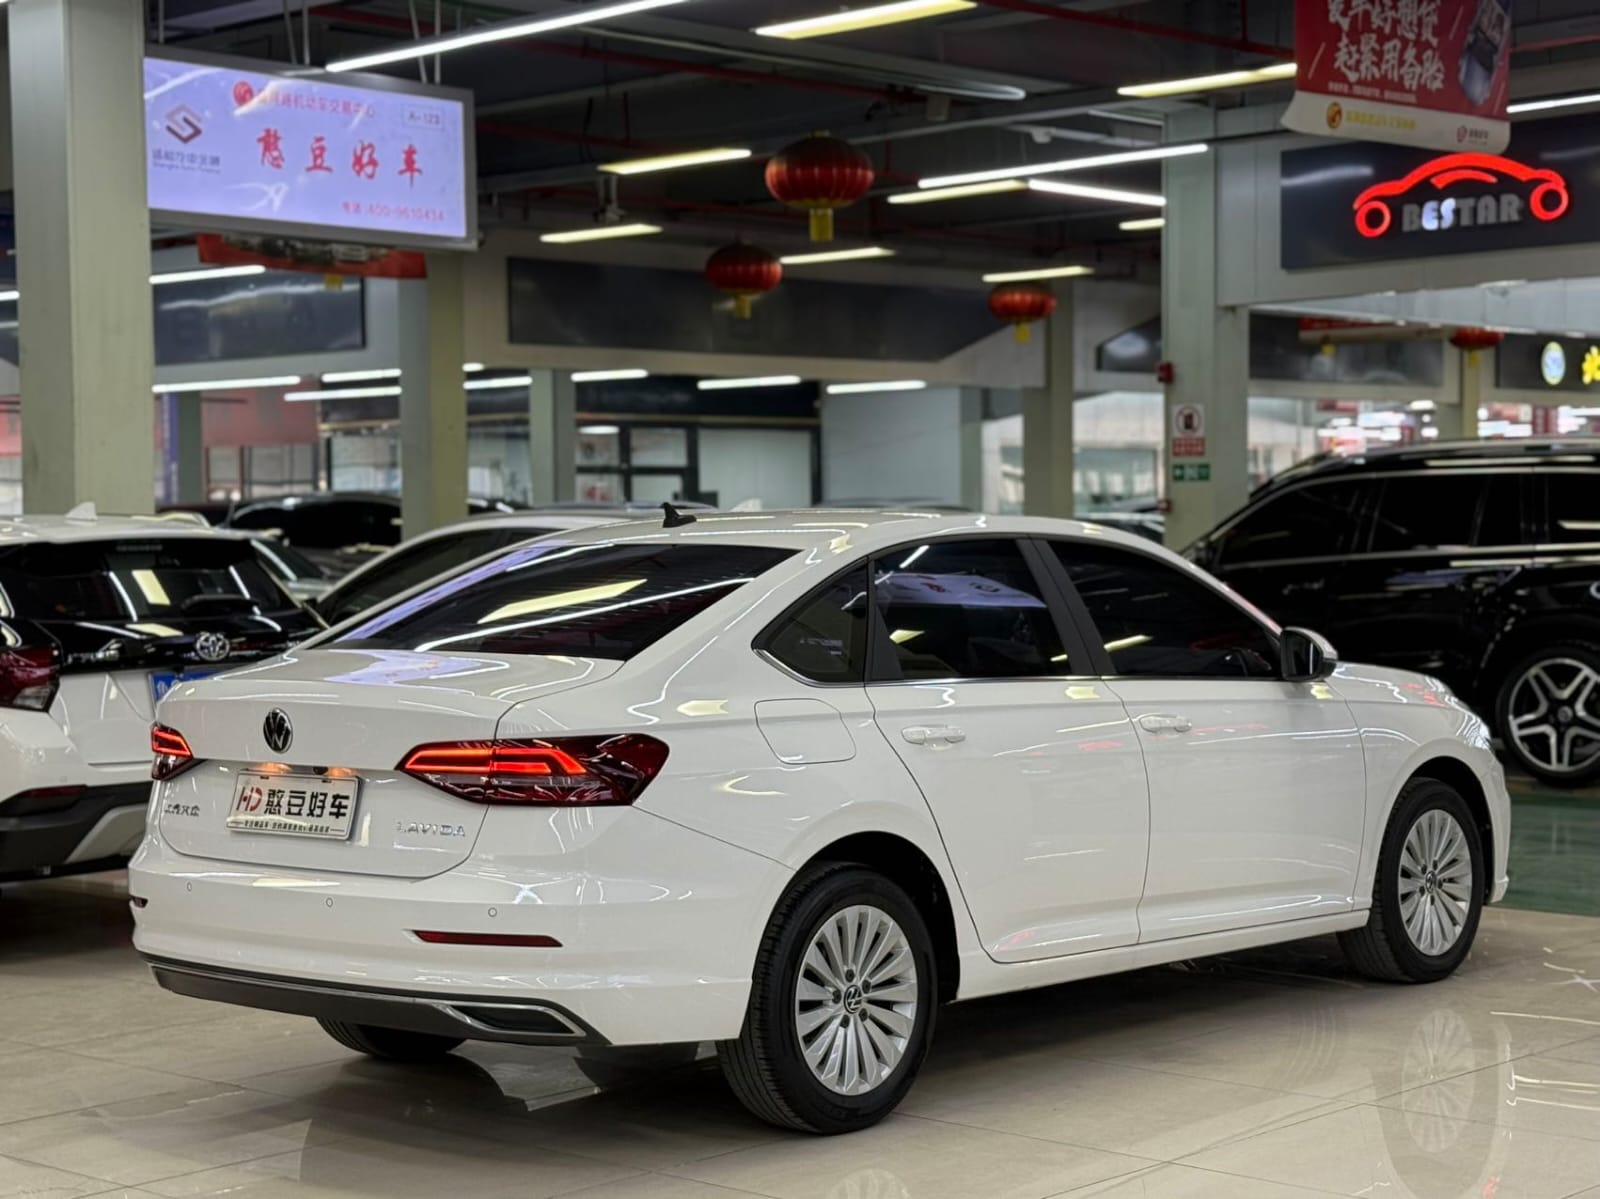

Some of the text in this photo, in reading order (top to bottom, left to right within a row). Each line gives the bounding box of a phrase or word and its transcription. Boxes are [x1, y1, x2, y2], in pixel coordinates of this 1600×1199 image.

[256, 127, 423, 188] 憨豆好车
[1401, 193, 1523, 232] BESTAR
[264, 788, 350, 819] 憨豆好车
[396, 820, 466, 838] LAVIDA
